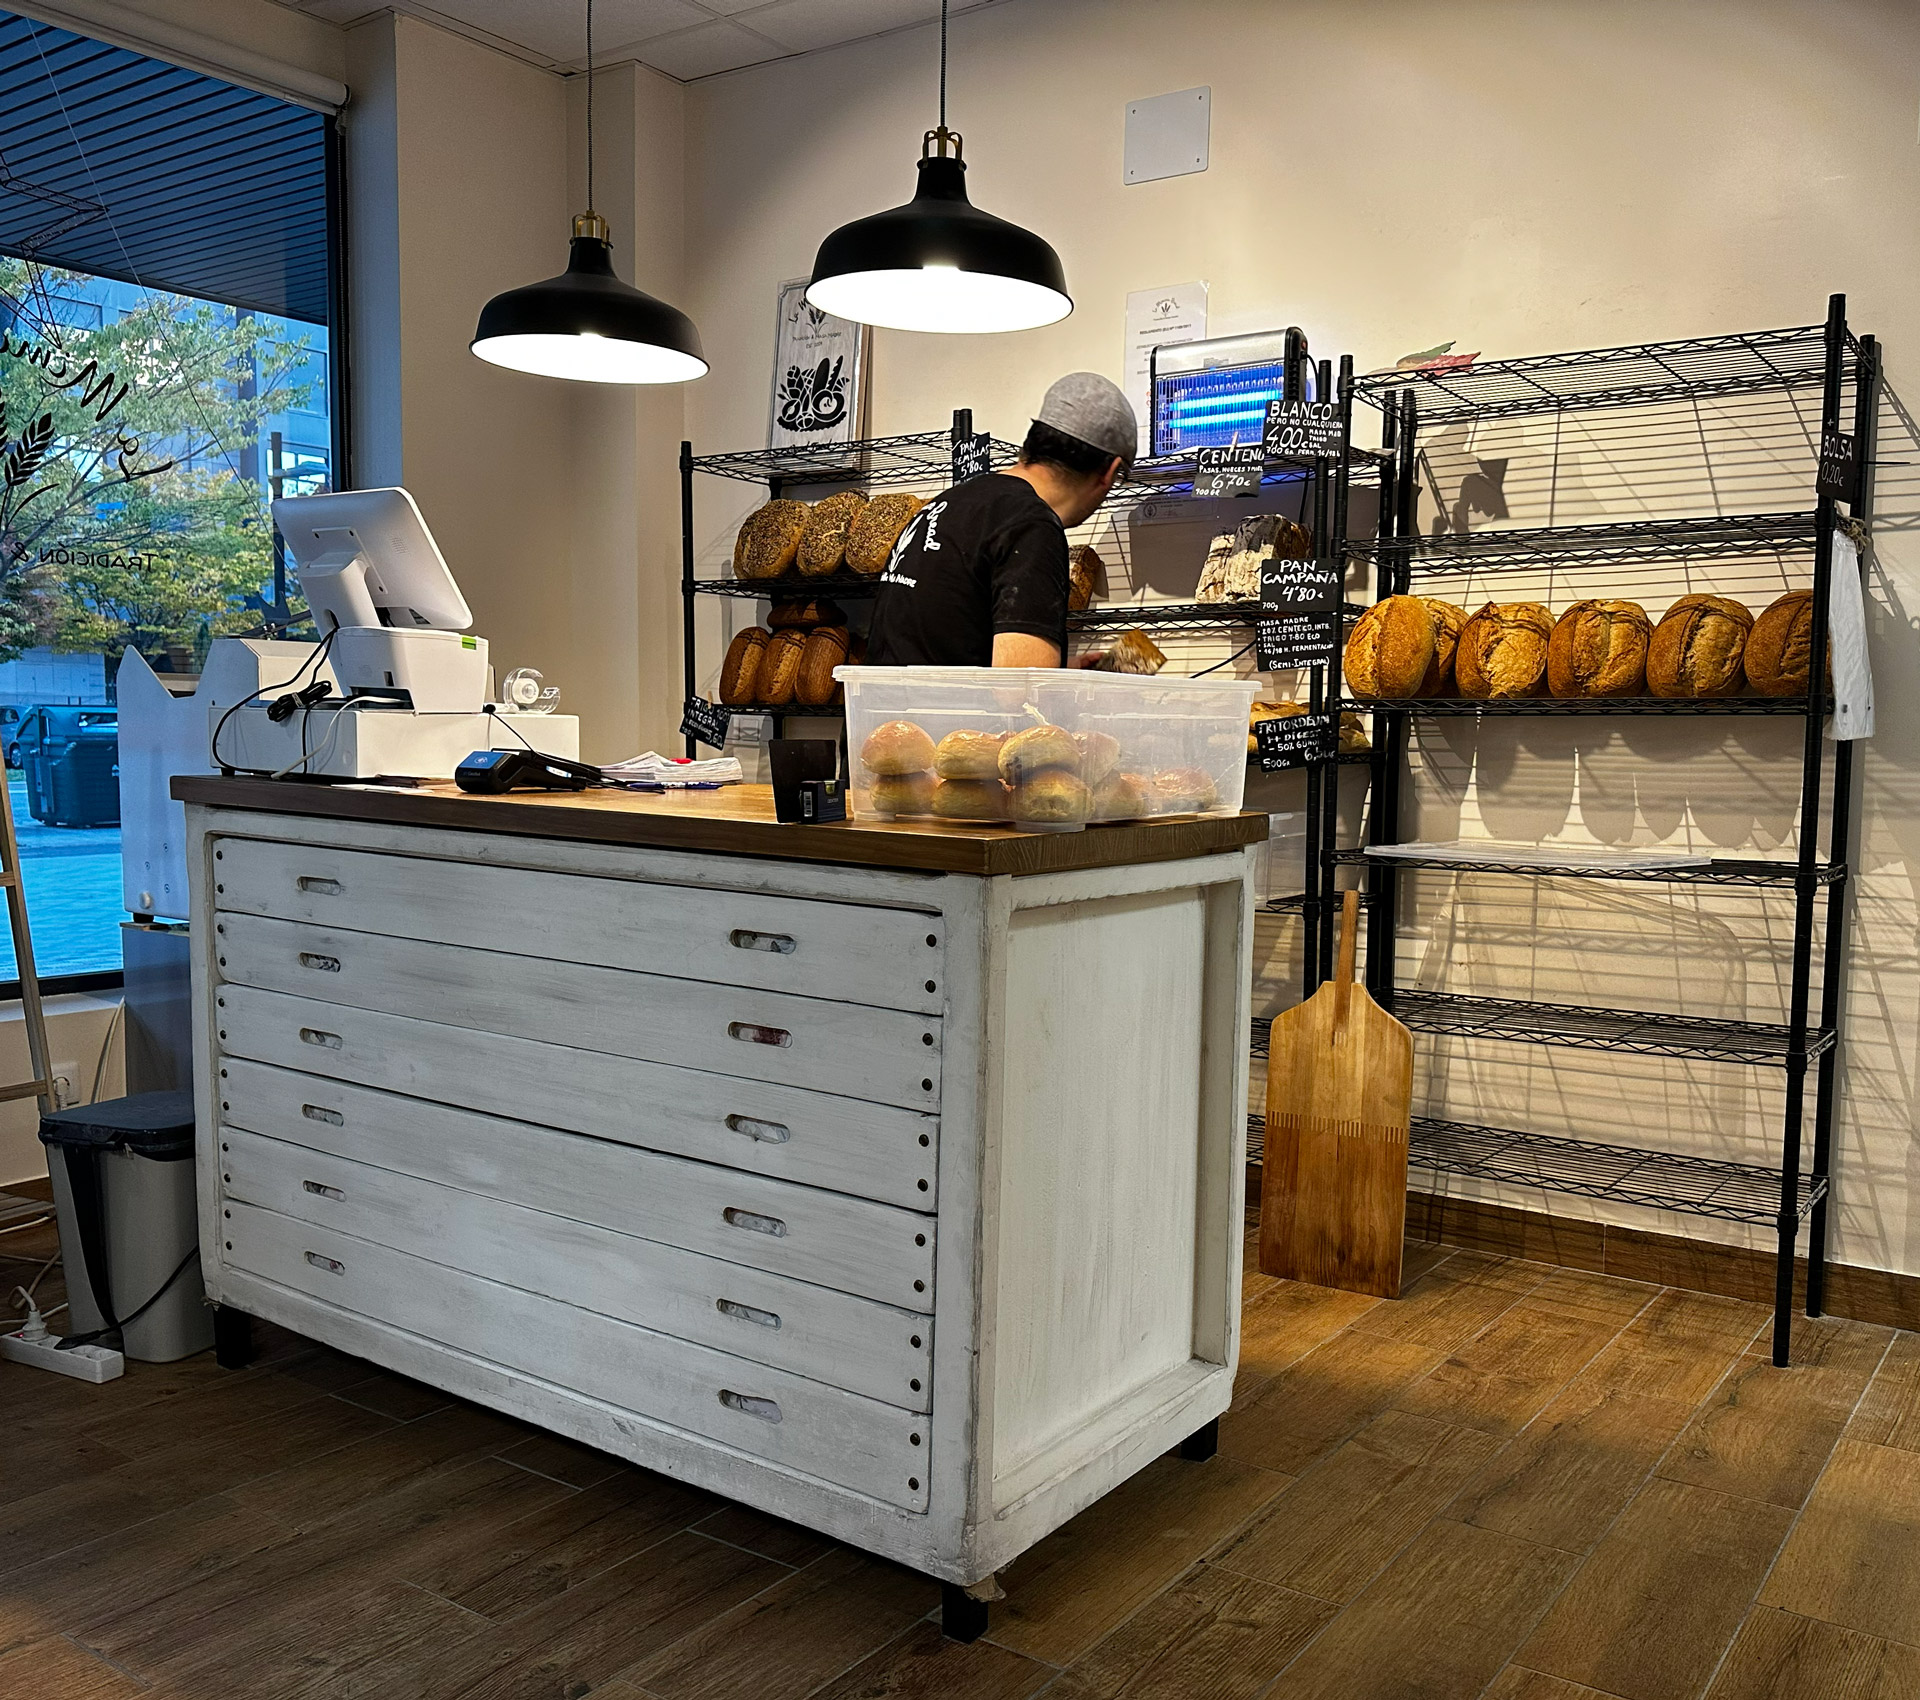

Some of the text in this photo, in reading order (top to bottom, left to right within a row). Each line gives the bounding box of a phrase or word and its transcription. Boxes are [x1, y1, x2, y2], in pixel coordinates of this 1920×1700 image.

[1270, 401, 1332, 420] BLANCO
[1303, 419, 1343, 428] CUALQUIERA
[954, 444, 989, 466] SEMILLAS
[960, 439, 977, 455] PAN
[1200, 448, 1264, 464] CENTENO
[1823, 435, 1853, 460] BOLSA
[1822, 461, 1844, 486] 0,20€
[1280, 560, 1316, 573] PAN
[1263, 570, 1338, 584] CAMPAÑA
[1262, 602, 1278, 611] 700g
[691, 696, 714, 715] TRIGO
[688, 708, 719, 731] INTEGRAL
[1258, 715, 1330, 734] TRITORDEUM
